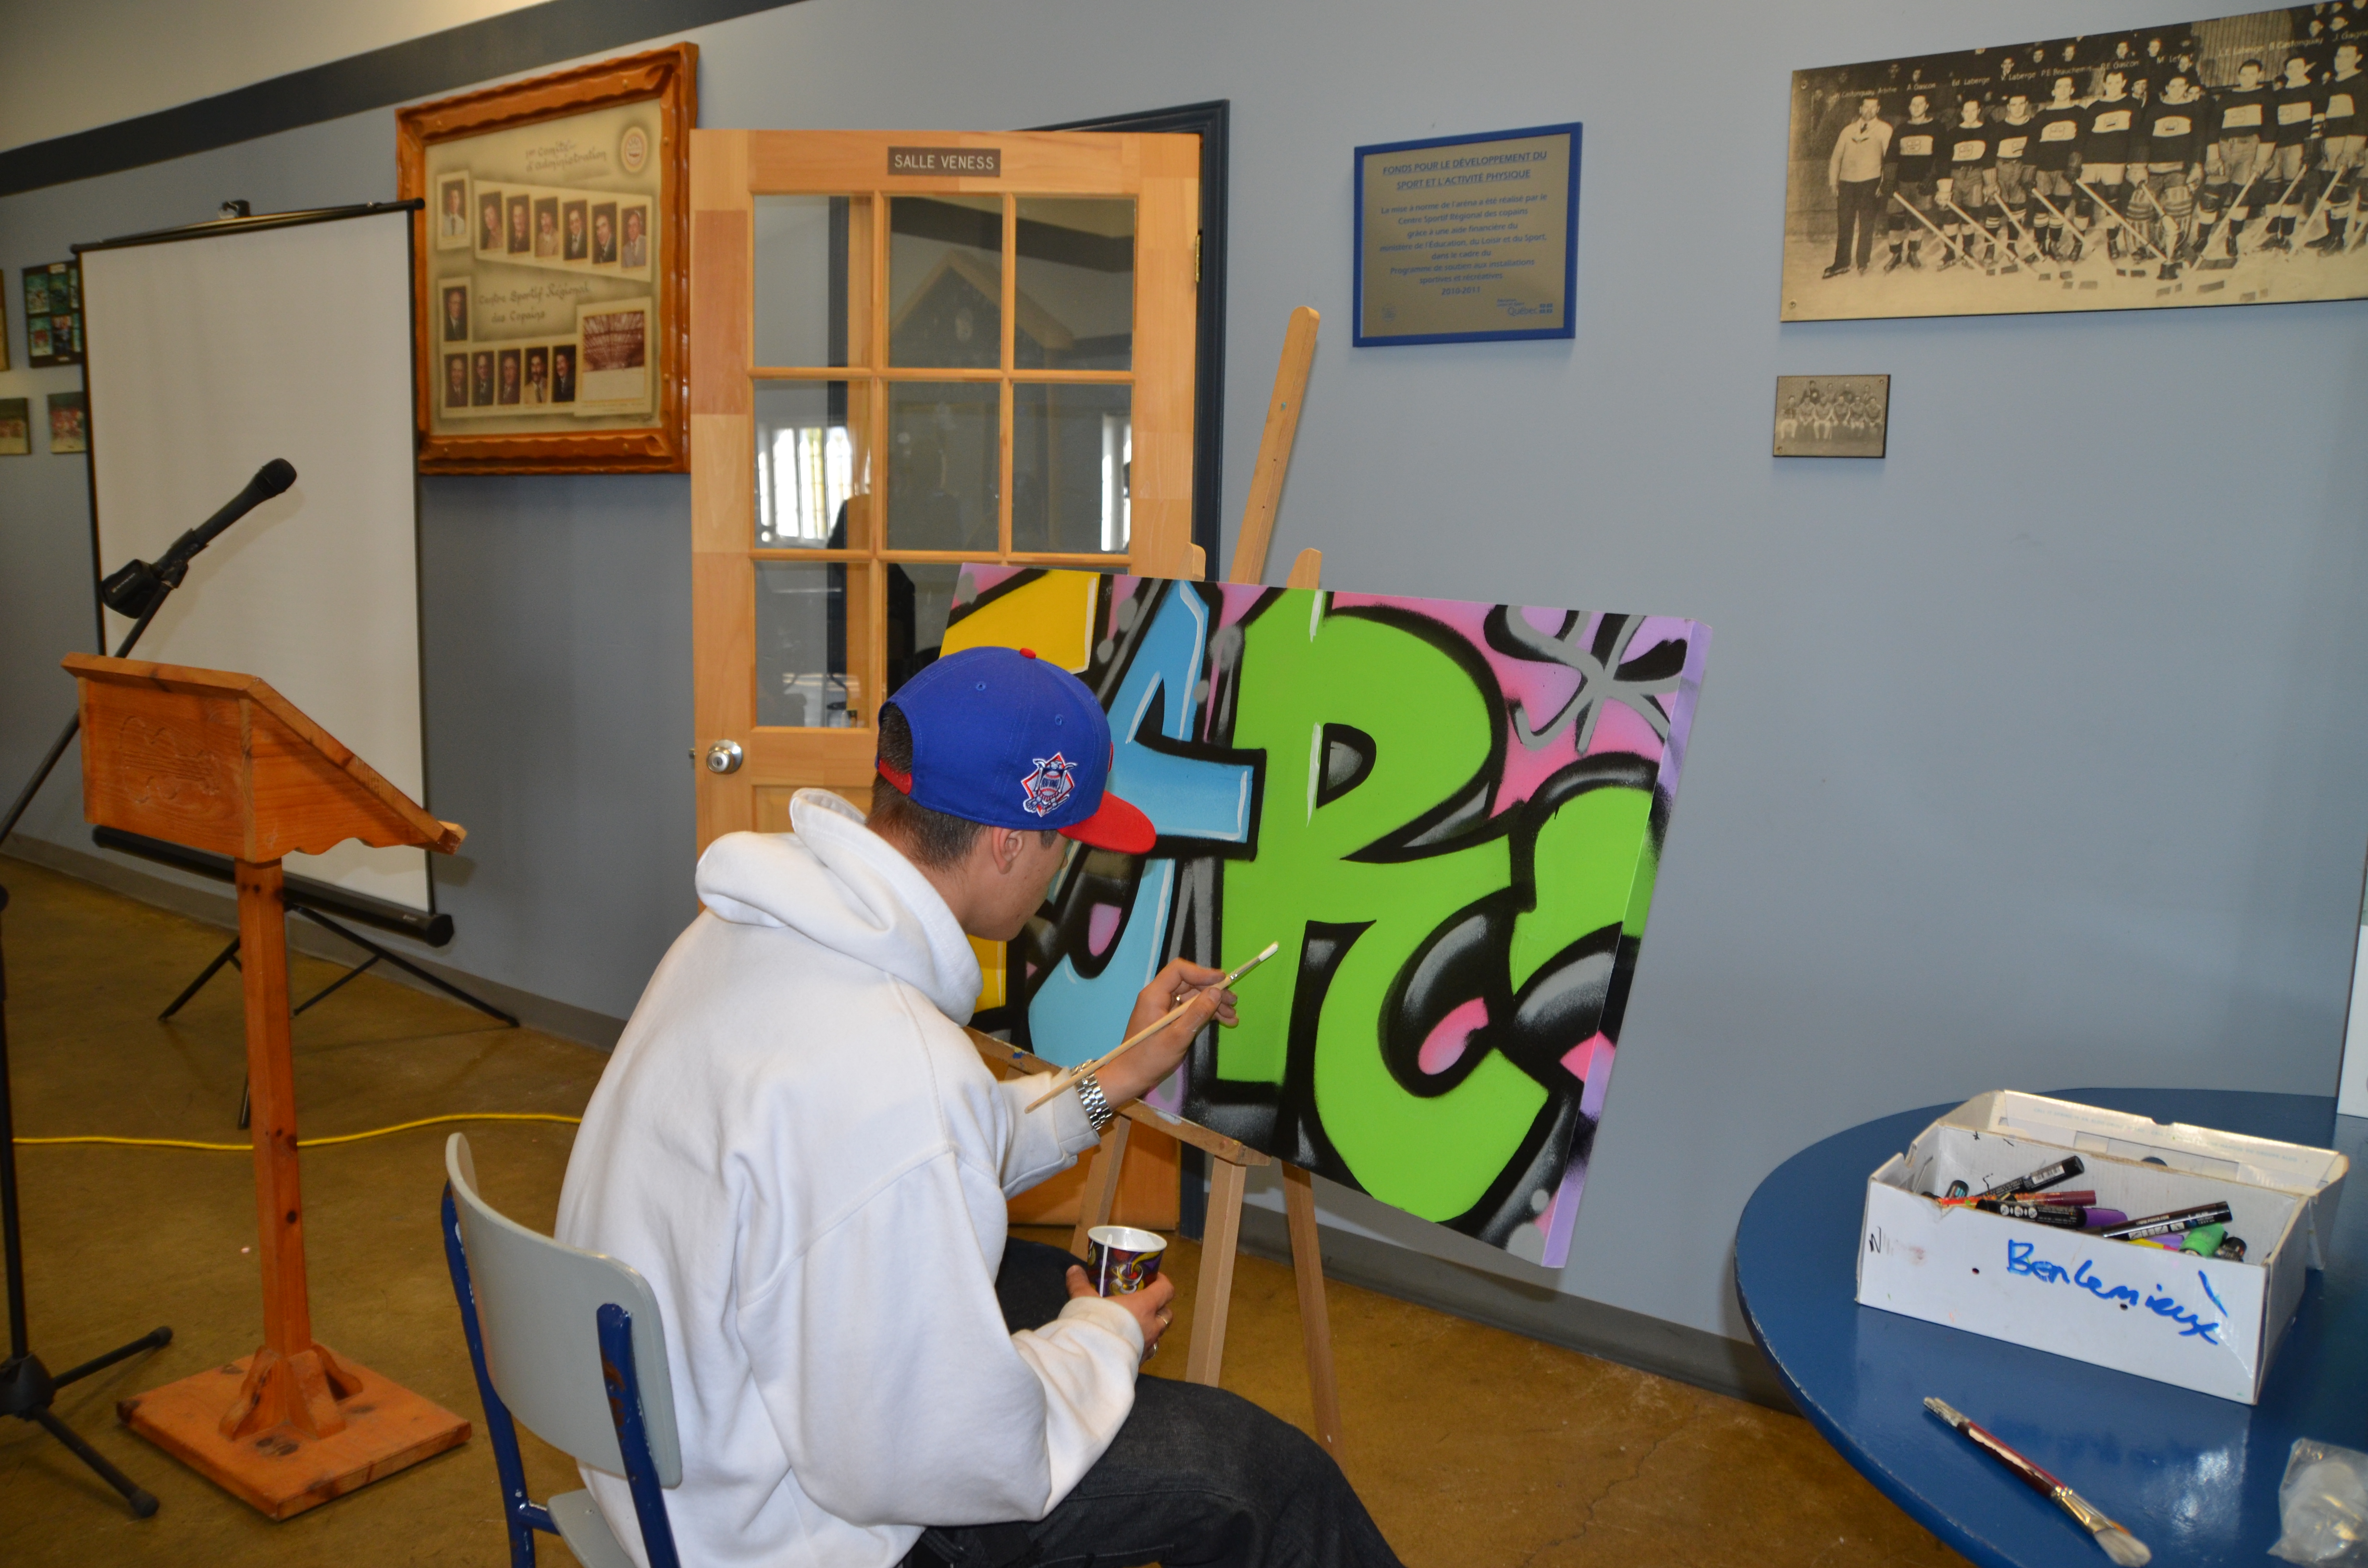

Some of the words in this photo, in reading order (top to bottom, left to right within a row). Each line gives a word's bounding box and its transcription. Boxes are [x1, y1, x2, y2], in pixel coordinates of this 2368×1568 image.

[1964, 77, 1991, 86] Laberge
[2009, 72, 2036, 81] Laberge
[894, 154, 936, 169] SALLE
[940, 155, 995, 170] VENESS
[1383, 164, 1412, 175] FONDS
[1415, 161, 1439, 172] POUR
[1441, 160, 1450, 169] LE
[1453, 152, 1531, 168] DÉVELOPPEMENT
[1533, 151, 1547, 160] DU
[1397, 179, 1424, 190] SPORT
[1426, 178, 1437, 188] ET
[1438, 172, 1484, 185] L'ACTIVITÉ
[1486, 169, 1531, 181] PHYSIQUE
[1485, 196, 1498, 205] été
[1499, 195, 1524, 204] réalisé
[1525, 194, 1539, 204] par
[1424, 214, 1448, 224] Sportif
[1450, 211, 1482, 222] Régional
[1499, 208, 1528, 218] copains
[1468, 223, 1506, 233] financière
[1481, 236, 1501, 245] Loisir
[1390, 267, 1431, 276] Programme
